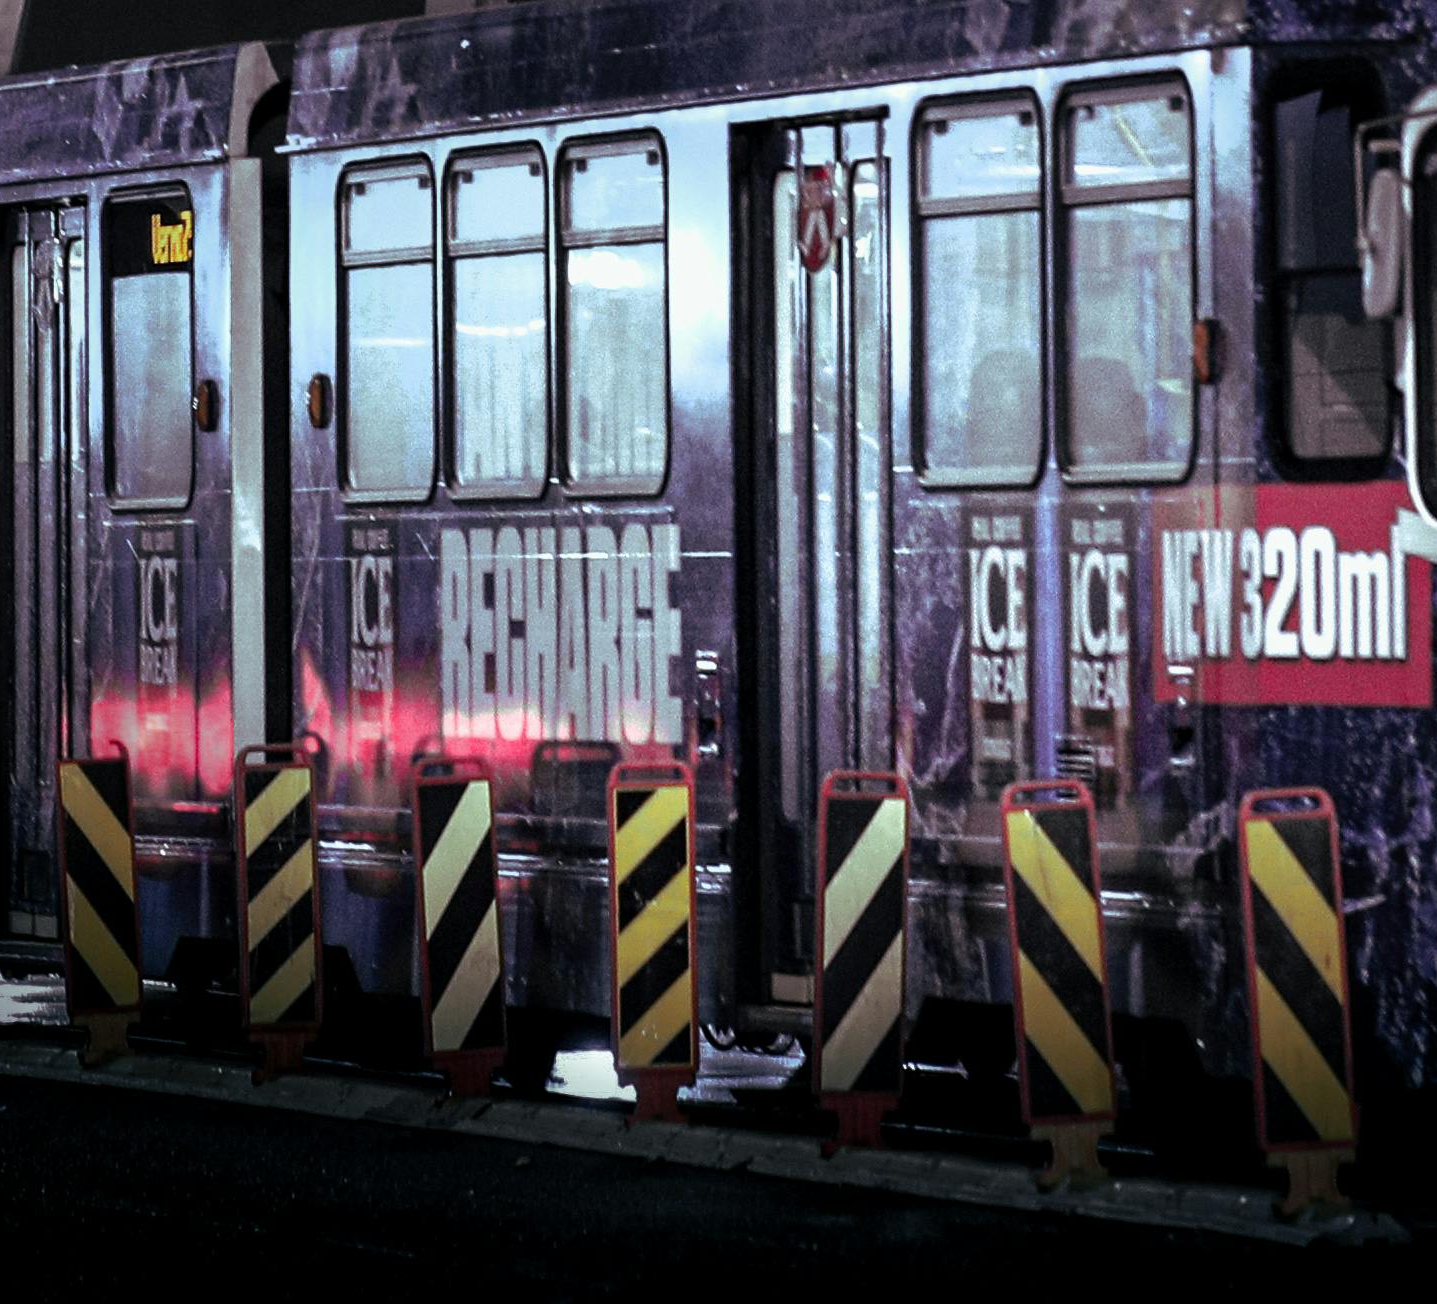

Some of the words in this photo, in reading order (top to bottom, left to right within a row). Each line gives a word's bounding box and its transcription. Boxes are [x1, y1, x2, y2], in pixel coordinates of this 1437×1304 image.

[139, 555, 178, 642] ICE
[350, 554, 393, 646] ICE
[440, 523, 683, 745] RECHARGE
[968, 545, 1028, 653] ICE
[1068, 549, 1130, 656] ICE
[1163, 528, 1234, 660] NEW
[1239, 523, 1407, 661] 320ml
